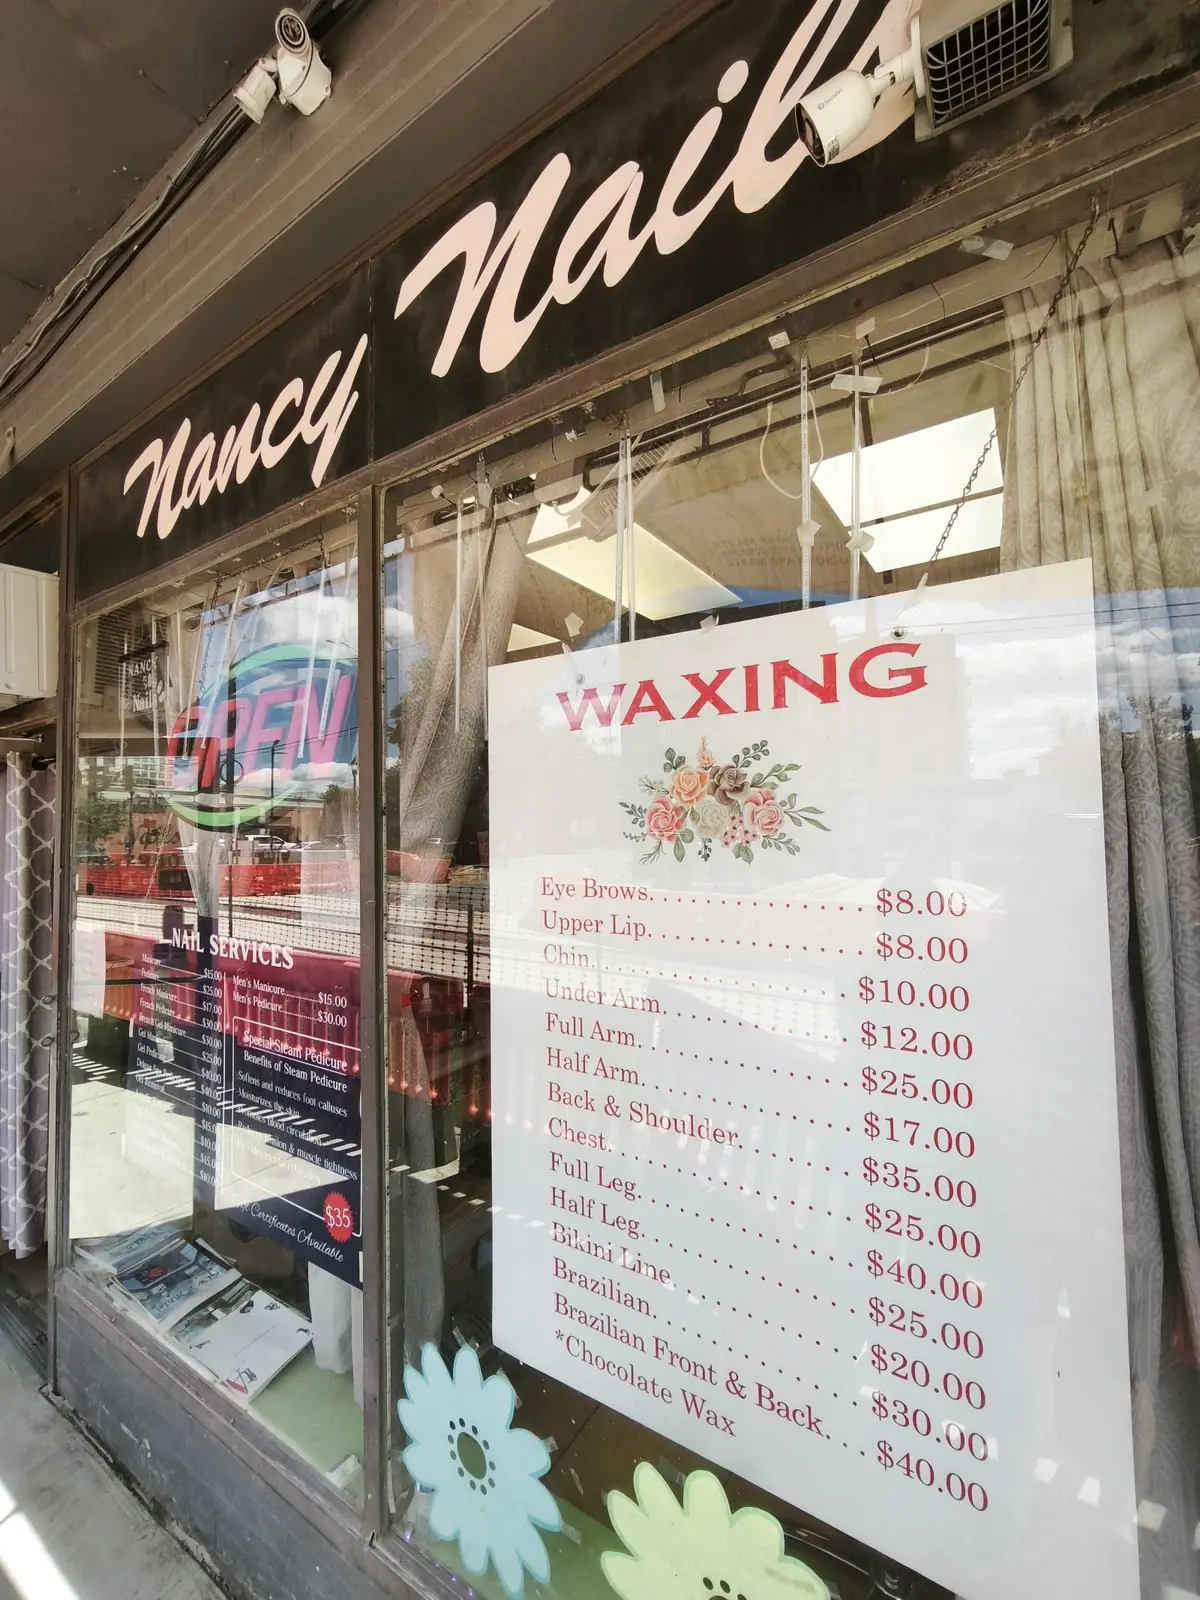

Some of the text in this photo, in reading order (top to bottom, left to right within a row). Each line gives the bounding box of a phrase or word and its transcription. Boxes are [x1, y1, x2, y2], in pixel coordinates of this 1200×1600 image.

[123, 333, 368, 540] Nancy
[556, 641, 929, 731] WAXING
[163, 675, 352, 789] OPEN
[541, 876, 967, 917] Eye Brows $8.00
[172, 927, 293, 970] NAIL SERVICES
[542, 909, 968, 964] Upper Lip $8.00
[142, 953, 222, 981] Manicure $15.00
[543, 944, 970, 1012] Chin $10.00
[140, 983, 222, 1015] French Manicure $17.00
[202, 985, 222, 998] $25.00
[232, 975, 347, 1009] Men's Manicure $15.00
[232, 991, 347, 1028] Men's Pedicure $30.00
[139, 1013, 155, 1027] French
[164, 1021, 187, 1037] Manicure
[202, 1035, 222, 1050] $30.00
[140, 998, 222, 1033] French Pedicure $30.00
[544, 977, 973, 1060] Under Arm $12.00
[137, 1042, 146, 1053] Gel
[201, 1068, 222, 1084] $40.00
[138, 1027, 147, 1038] Gel
[202, 1051, 222, 1067] $25.00
[243, 1029, 348, 1072] Special Steam Pedicure
[545, 1012, 973, 1109] Full Arm $25.00
[243, 1050, 348, 1093] Benefits of Steam Pedicure
[201, 1101, 221, 1118] $10.00
[261, 1080, 273, 1092] and
[275, 1084, 301, 1102] reduces
[303, 1092, 316, 1107] foot
[318, 1098, 348, 1118] calluses
[273, 1101, 284, 1113] the
[285, 1105, 300, 1117] skin
[546, 1046, 975, 1158] Half Arm $17.00
[200, 1135, 219, 1152] $10.0
[201, 1118, 219, 1136] $15.0
[267, 1115, 285, 1131] blood
[547, 1081, 977, 1208] Back & Shoulder $35.00
[200, 1153, 219, 1170] $15.0
[288, 1142, 295, 1154] &
[297, 1147, 321, 1166] muscle
[324, 1158, 358, 1181] tightness
[548, 1117, 981, 1258] Chest $25.00
[250, 1203, 296, 1237] Certificates
[297, 1229, 345, 1263] Available
[325, 1205, 351, 1229] $35
[549, 1151, 983, 1308] Full Leg $40.00
[550, 1186, 984, 1359] Half Leg $25.00
[551, 1221, 986, 1410] Bikini Line $20.00
[552, 1256, 989, 1461] Brazilian $30.00
[553, 1292, 989, 1512] Brazilian Front & Back $40.00
[680, 1388, 737, 1438] Wax
